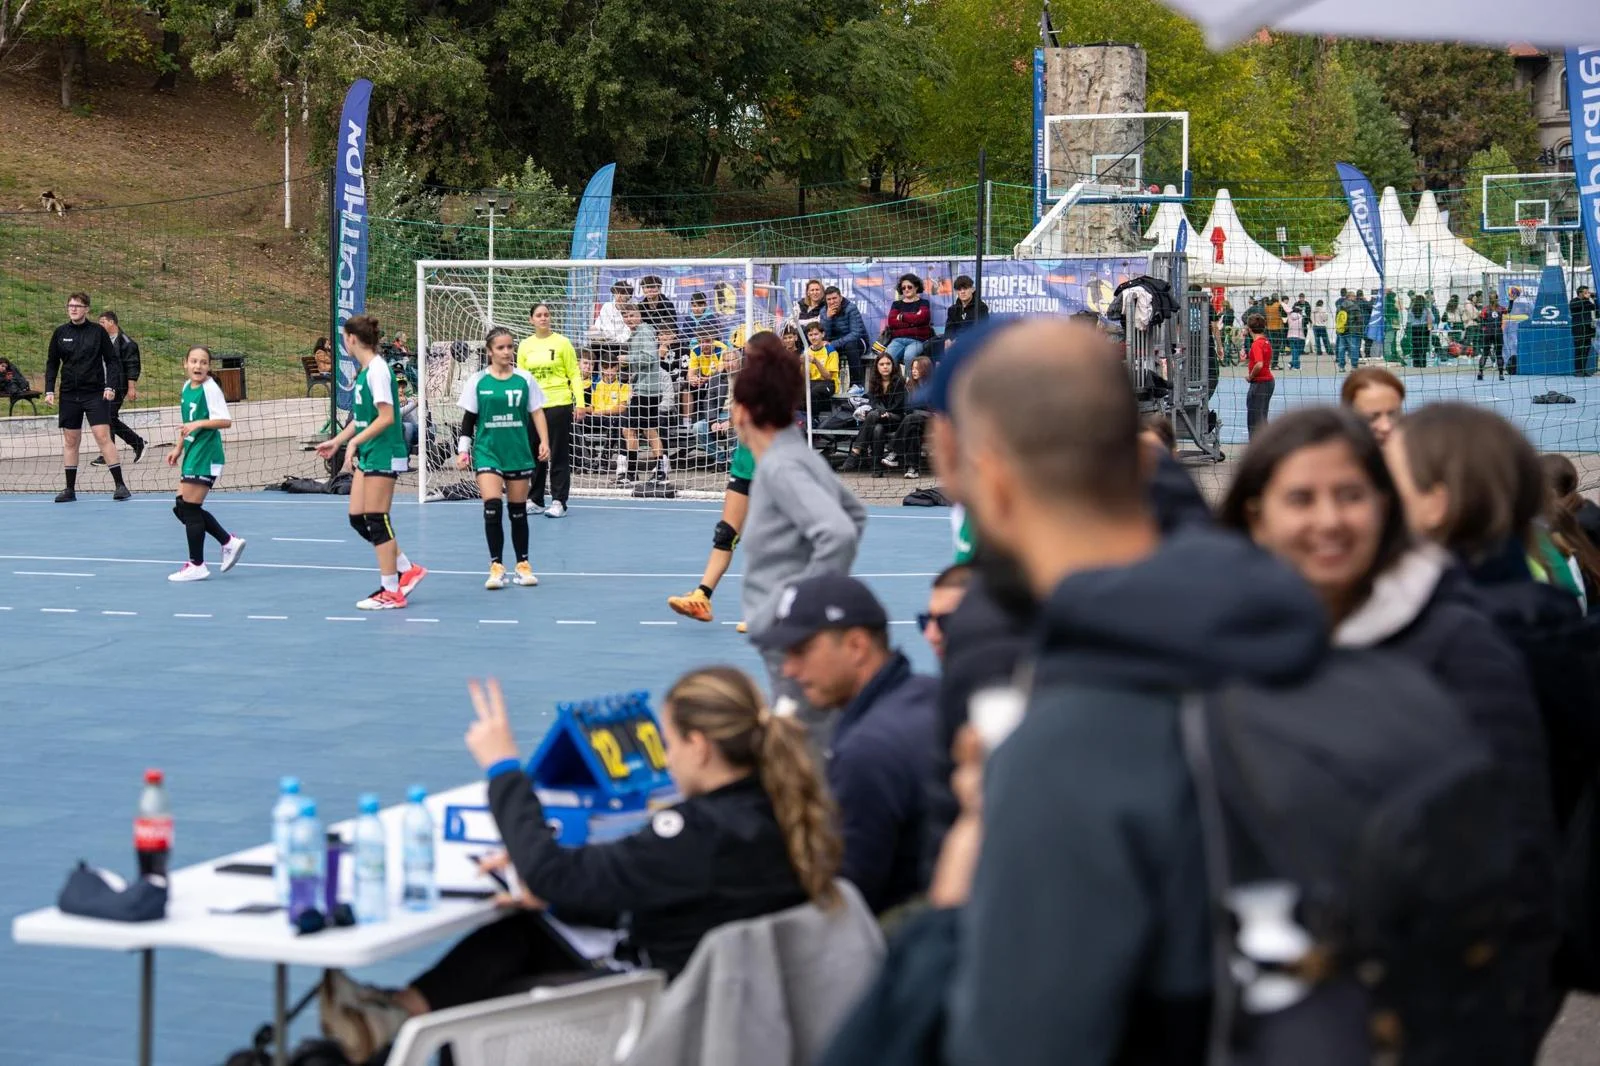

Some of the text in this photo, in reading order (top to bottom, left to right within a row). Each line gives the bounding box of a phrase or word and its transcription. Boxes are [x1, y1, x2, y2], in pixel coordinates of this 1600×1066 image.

[981, 274, 1046, 297] TROFEUL
[505, 389, 523, 407] 17
[189, 402, 197, 421] 7
